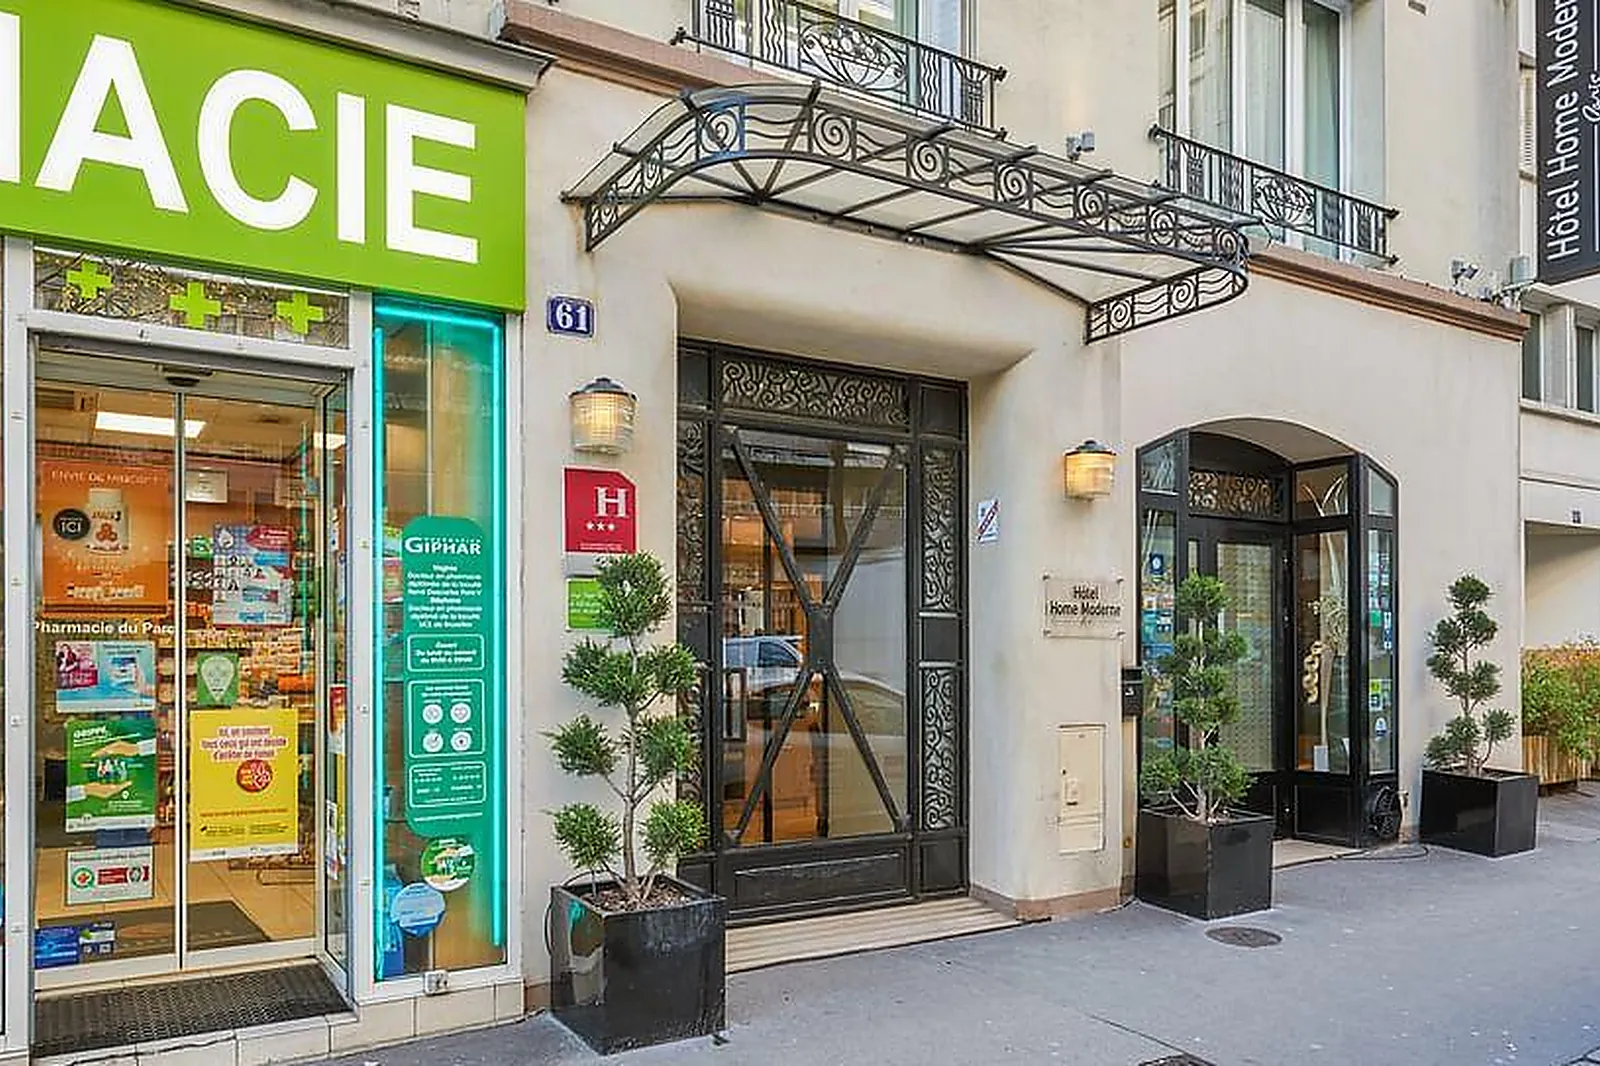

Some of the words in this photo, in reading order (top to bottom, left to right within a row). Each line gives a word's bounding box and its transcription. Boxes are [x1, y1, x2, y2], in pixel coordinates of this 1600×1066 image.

[1547, 92, 1580, 178] Home
[1547, 180, 1580, 260] Hôtel
[556, 302, 587, 331] 61
[595, 486, 629, 518] H
[405, 537, 481, 554] GIPHAR
[1073, 583, 1099, 599] Hôtel
[1050, 601, 1078, 615] Home
[1081, 602, 1121, 616] Moderne
[119, 621, 138, 634] du
